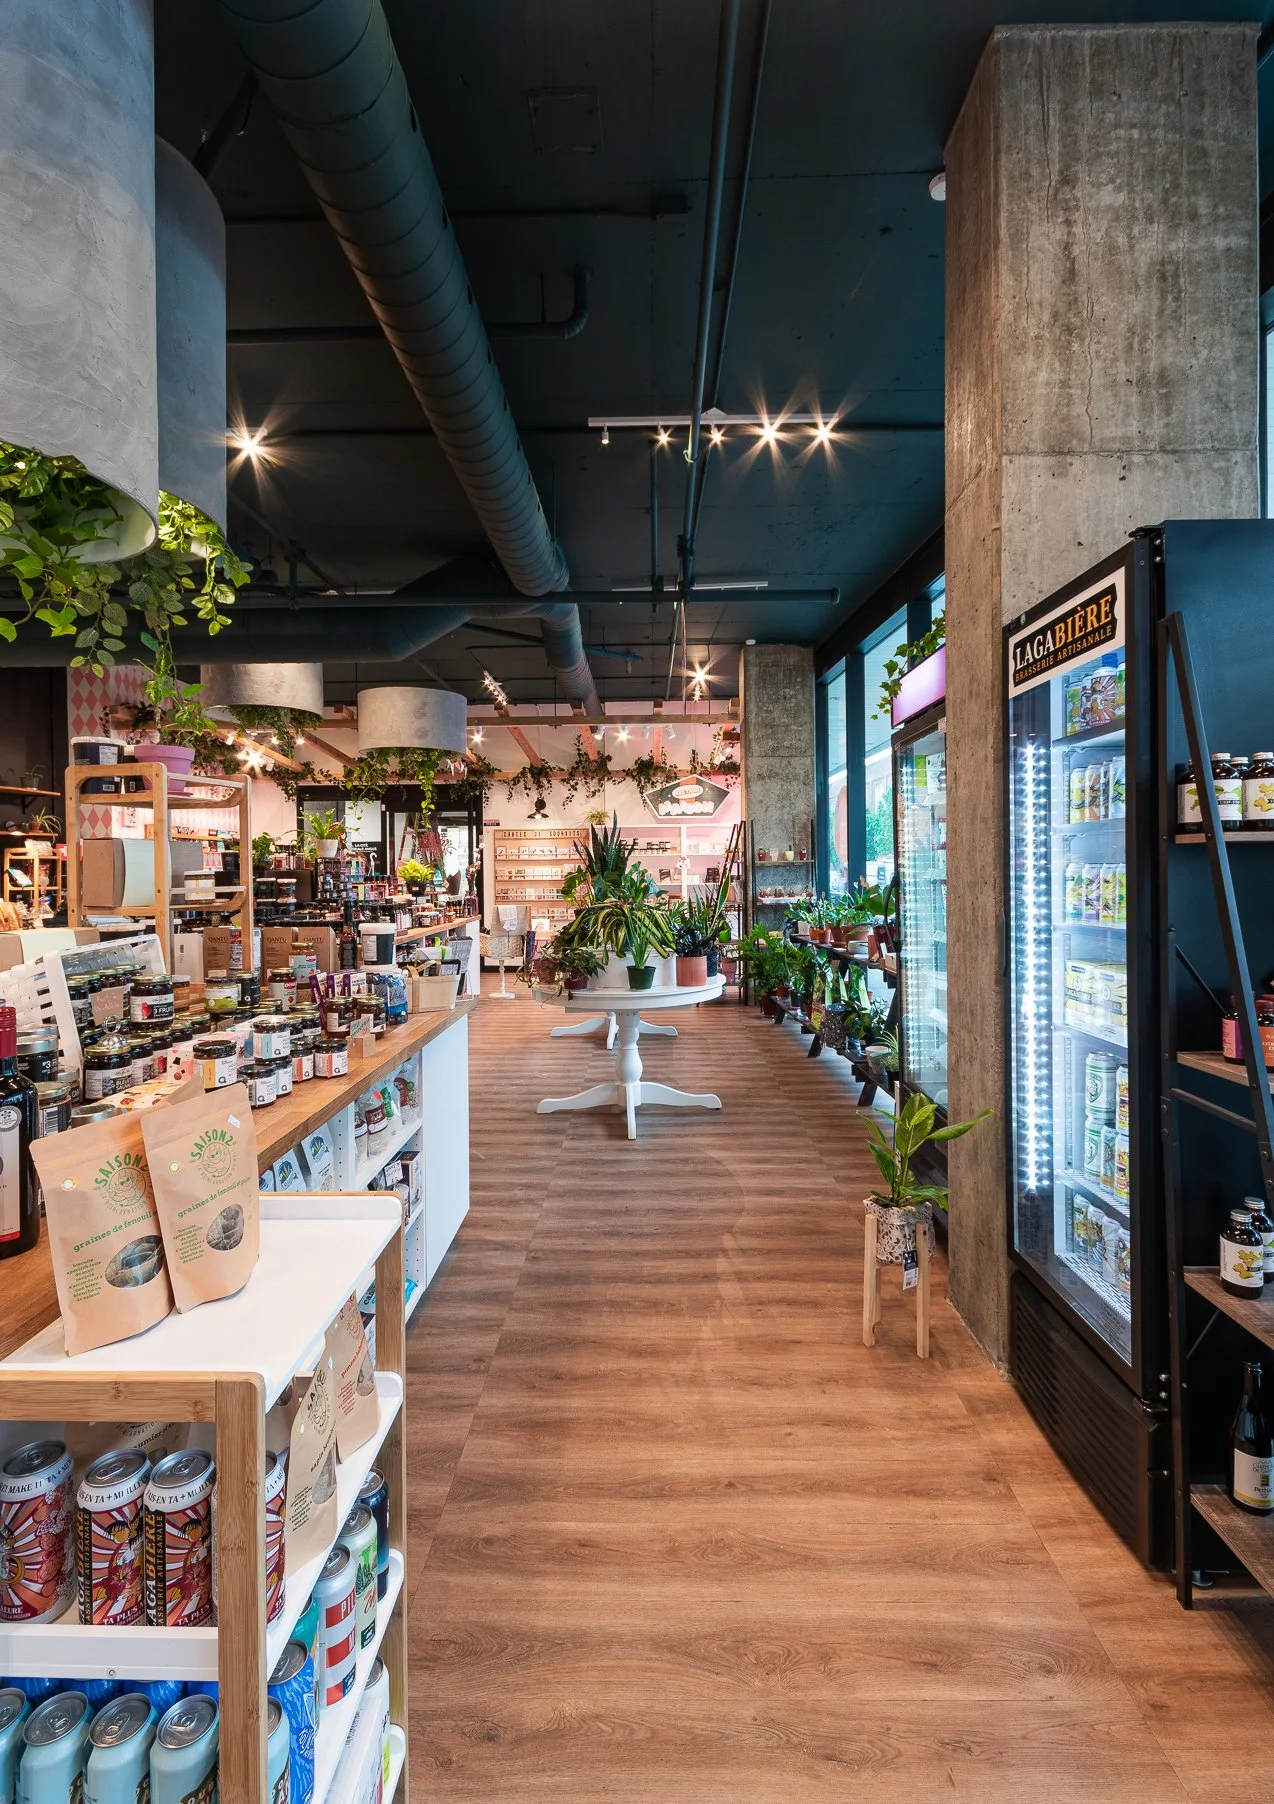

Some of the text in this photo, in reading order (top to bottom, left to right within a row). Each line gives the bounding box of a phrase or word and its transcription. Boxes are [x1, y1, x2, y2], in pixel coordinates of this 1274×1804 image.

[1015, 594, 1112, 671] LAGABIÈRE
[1015, 625, 1112, 682] BRASSERIE ARTISANALE
[190, 1128, 234, 1161] SAISON2
[177, 1198, 209, 1219] graines
[209, 1192, 218, 1202] de
[217, 1181, 237, 1197] fenouil
[73, 1230, 111, 1253] graines
[112, 1222, 123, 1234] de
[123, 1210, 153, 1229] fenouil
[7, 1482, 33, 1495] MAKE
[47, 1474, 57, 1484] TA
[94, 1493, 105, 1504] TA
[168, 1494, 179, 1505] TA
[102, 1614, 116, 1626] TA
[116, 1605, 138, 1623] PLUS
[177, 1615, 191, 1626] TA
